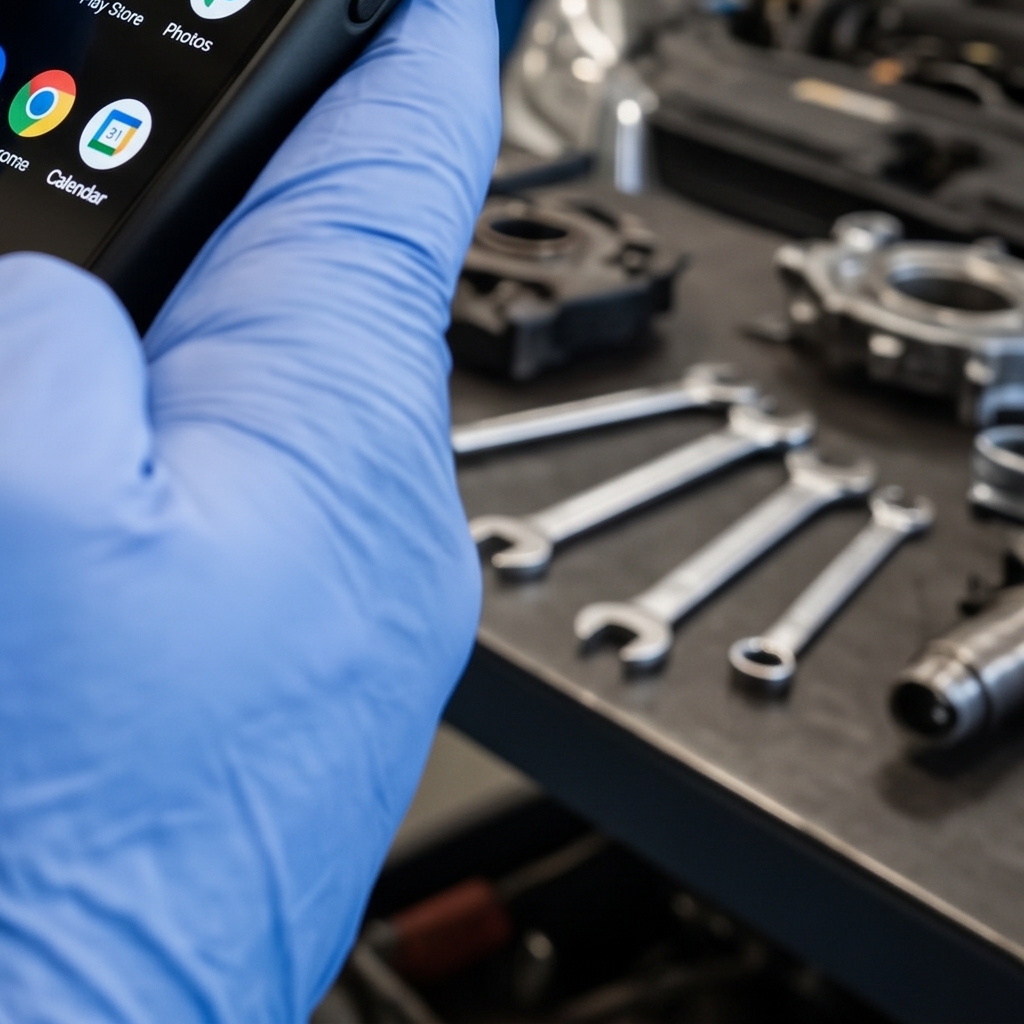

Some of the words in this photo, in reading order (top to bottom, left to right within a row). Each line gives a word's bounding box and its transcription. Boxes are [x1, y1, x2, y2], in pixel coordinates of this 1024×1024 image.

[108, 2, 144, 26] Store
[162, 22, 214, 53] Photos
[105, 127, 122, 141] 31
[46, 169, 108, 206] Calendar
